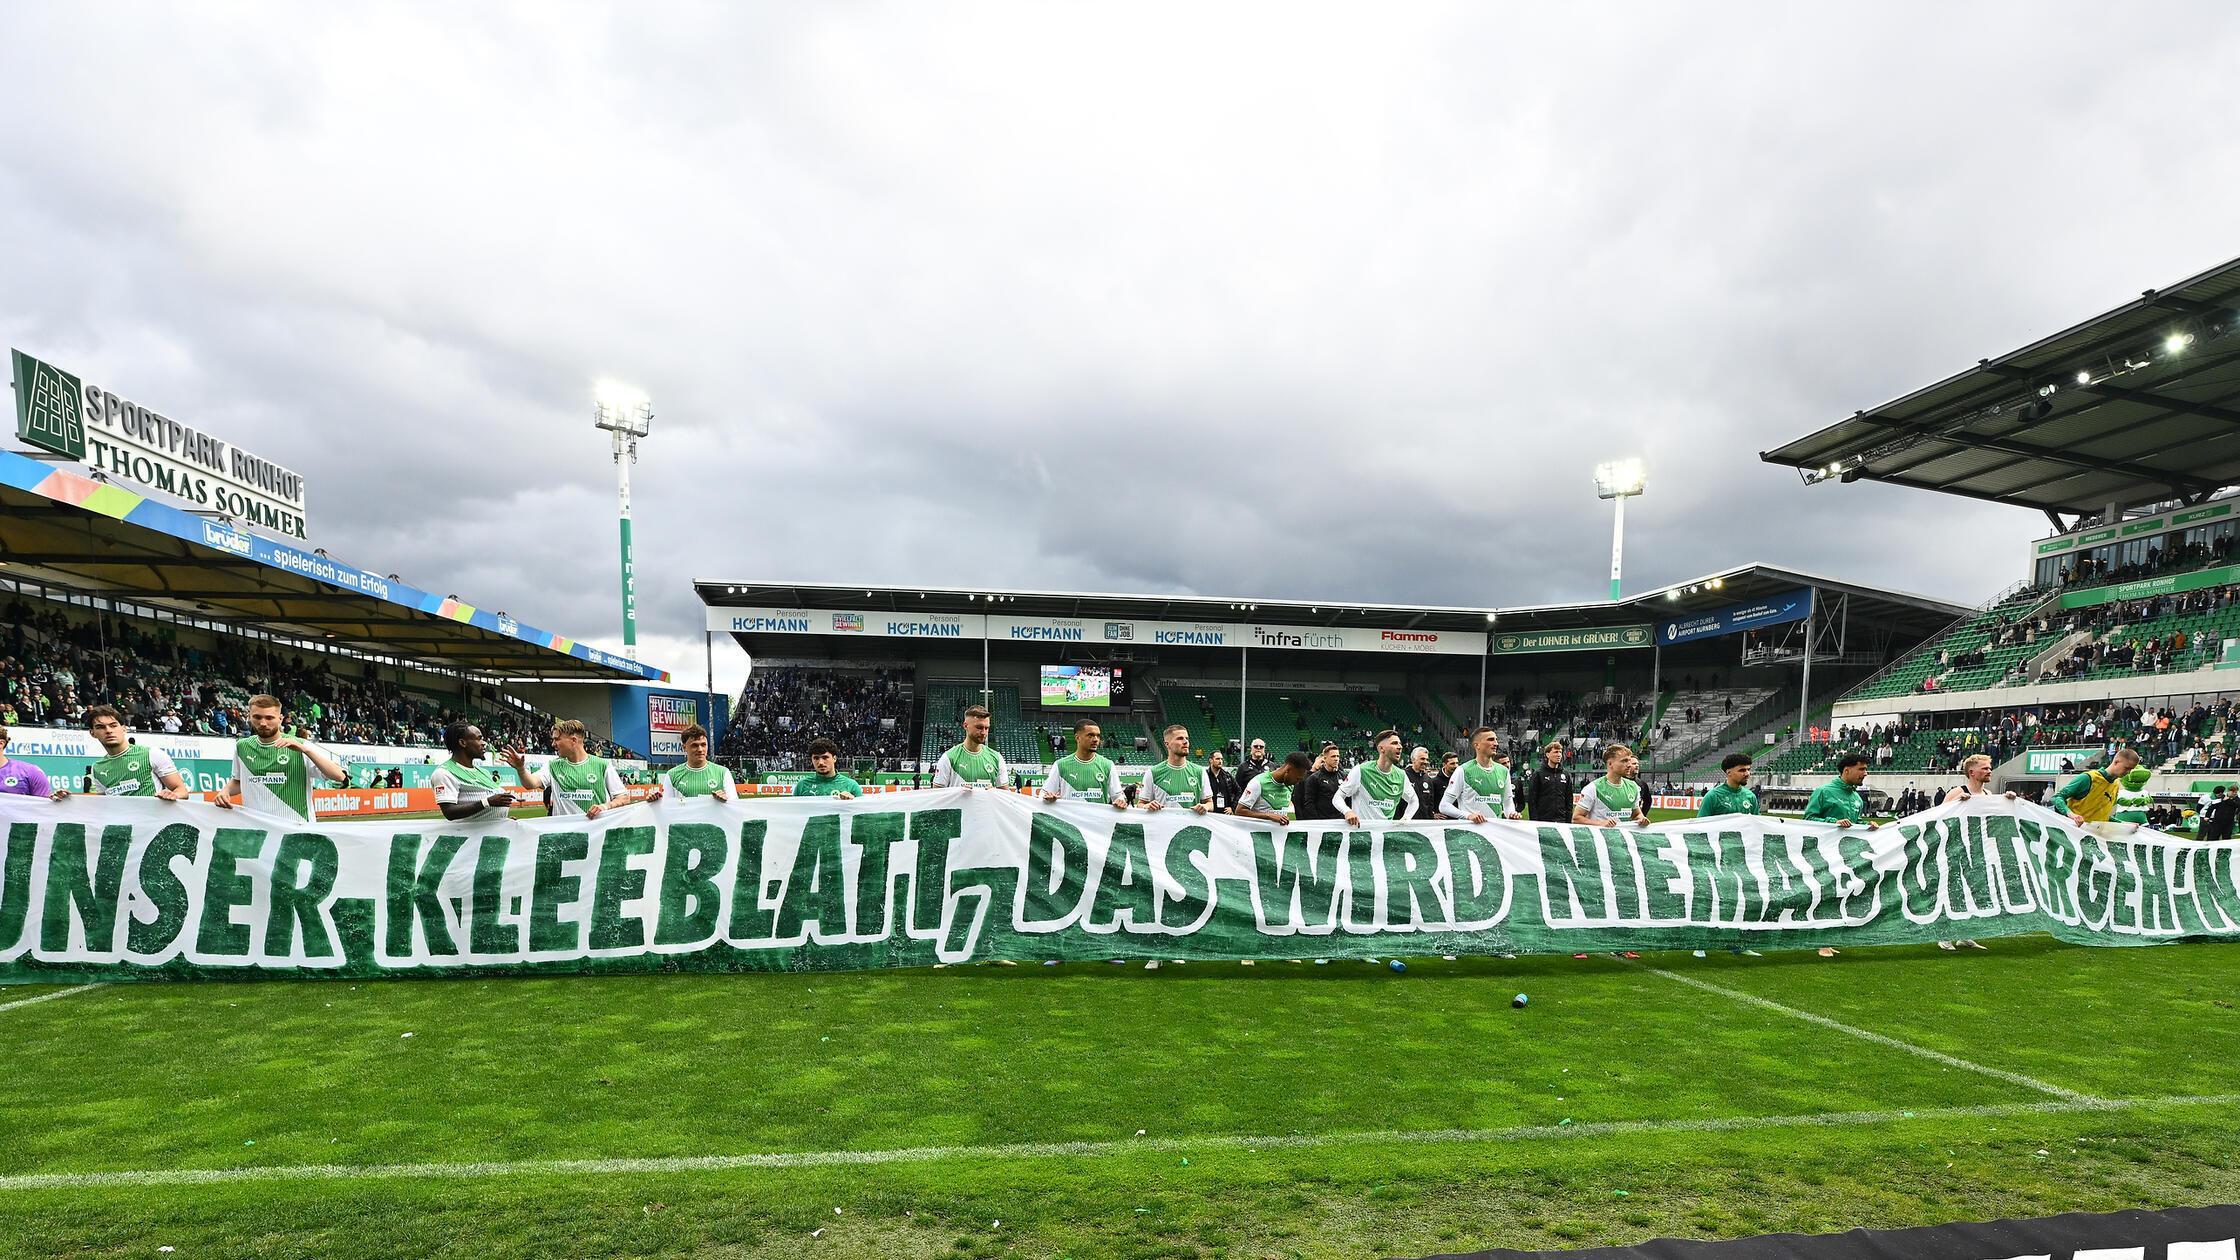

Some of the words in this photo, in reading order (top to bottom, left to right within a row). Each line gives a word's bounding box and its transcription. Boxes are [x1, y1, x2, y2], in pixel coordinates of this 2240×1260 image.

[85, 385, 225, 473] SPORTPARK
[231, 447, 304, 502] RONHOF
[88, 436, 208, 504] THOMAS
[215, 486, 307, 540] SOMMER
[274, 549, 335, 580] spielerisch
[337, 569, 358, 587] zum
[361, 574, 388, 600] Erfolg
[2118, 582, 2151, 592] SPORTPARK
[2152, 578, 2176, 588] RONHOF
[733, 618, 808, 631] HOFMANN
[888, 622, 960, 636] HOFMANN
[1678, 619, 1700, 629] ALBRECHT
[1011, 626, 1082, 640] HOFMANN
[1155, 631, 1223, 644] HOFMANN
[1381, 631, 1438, 642] Flamme
[1678, 626, 1697, 637] AIRPORT
[1261, 631, 1302, 646] infra
[1303, 632, 1343, 647] fürth
[1522, 637, 1537, 647] Der
[1538, 635, 1570, 646] LOHNER
[1571, 635, 1582, 645] ist
[1583, 632, 1619, 644] GRÜNER!
[651, 699, 695, 713] #VIELFALT
[652, 711, 695, 725] GEWINNT
[52, 731, 85, 741] Personal
[5, 742, 86, 756] HOFMANN
[652, 742, 684, 752] HOFMA
[249, 776, 285, 784] HOFMANN
[314, 794, 360, 812] machbar
[374, 793, 390, 810] mit
[391, 792, 408, 808] OBI
[1666, 798, 1688, 808] OBI
[1022, 812, 1211, 929] DAS
[1251, 827, 1504, 926] WIRD
[1537, 826, 1880, 921] NIEMALS
